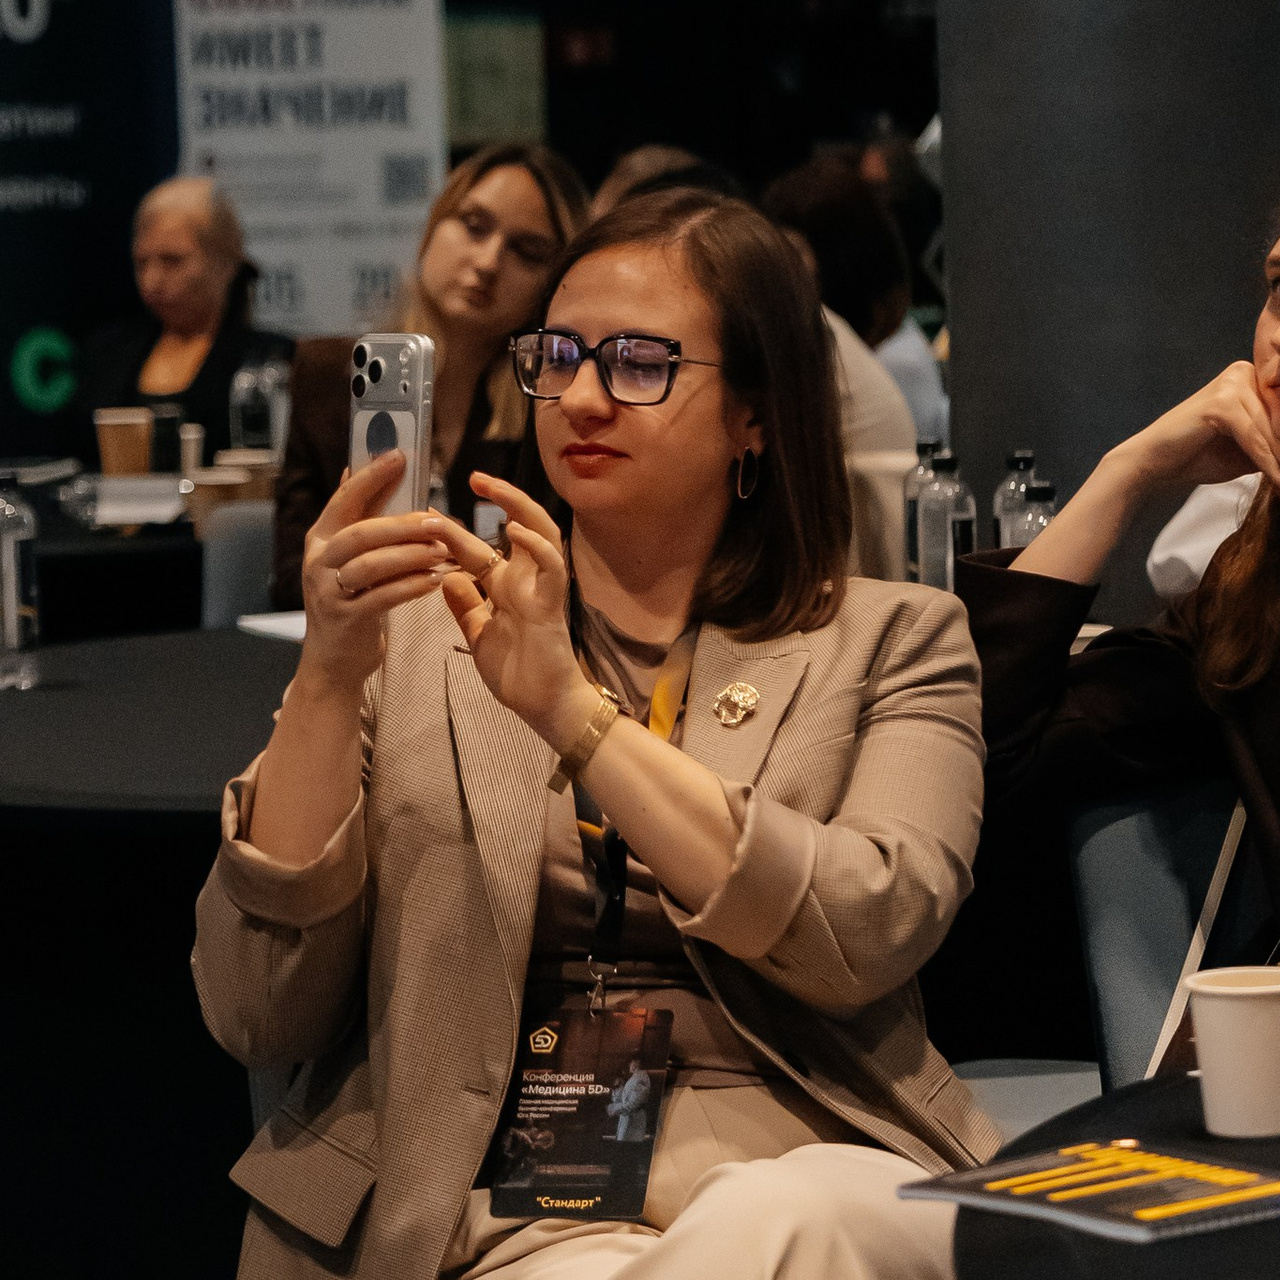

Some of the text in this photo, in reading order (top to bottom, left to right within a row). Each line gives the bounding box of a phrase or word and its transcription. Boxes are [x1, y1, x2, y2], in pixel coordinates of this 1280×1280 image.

[534, 1034, 552, 1048] 5D
[523, 1072, 595, 1083] Конференция
[521, 1085, 586, 1096] «Медицина
[536, 1196, 602, 1210] "Стандарт"
